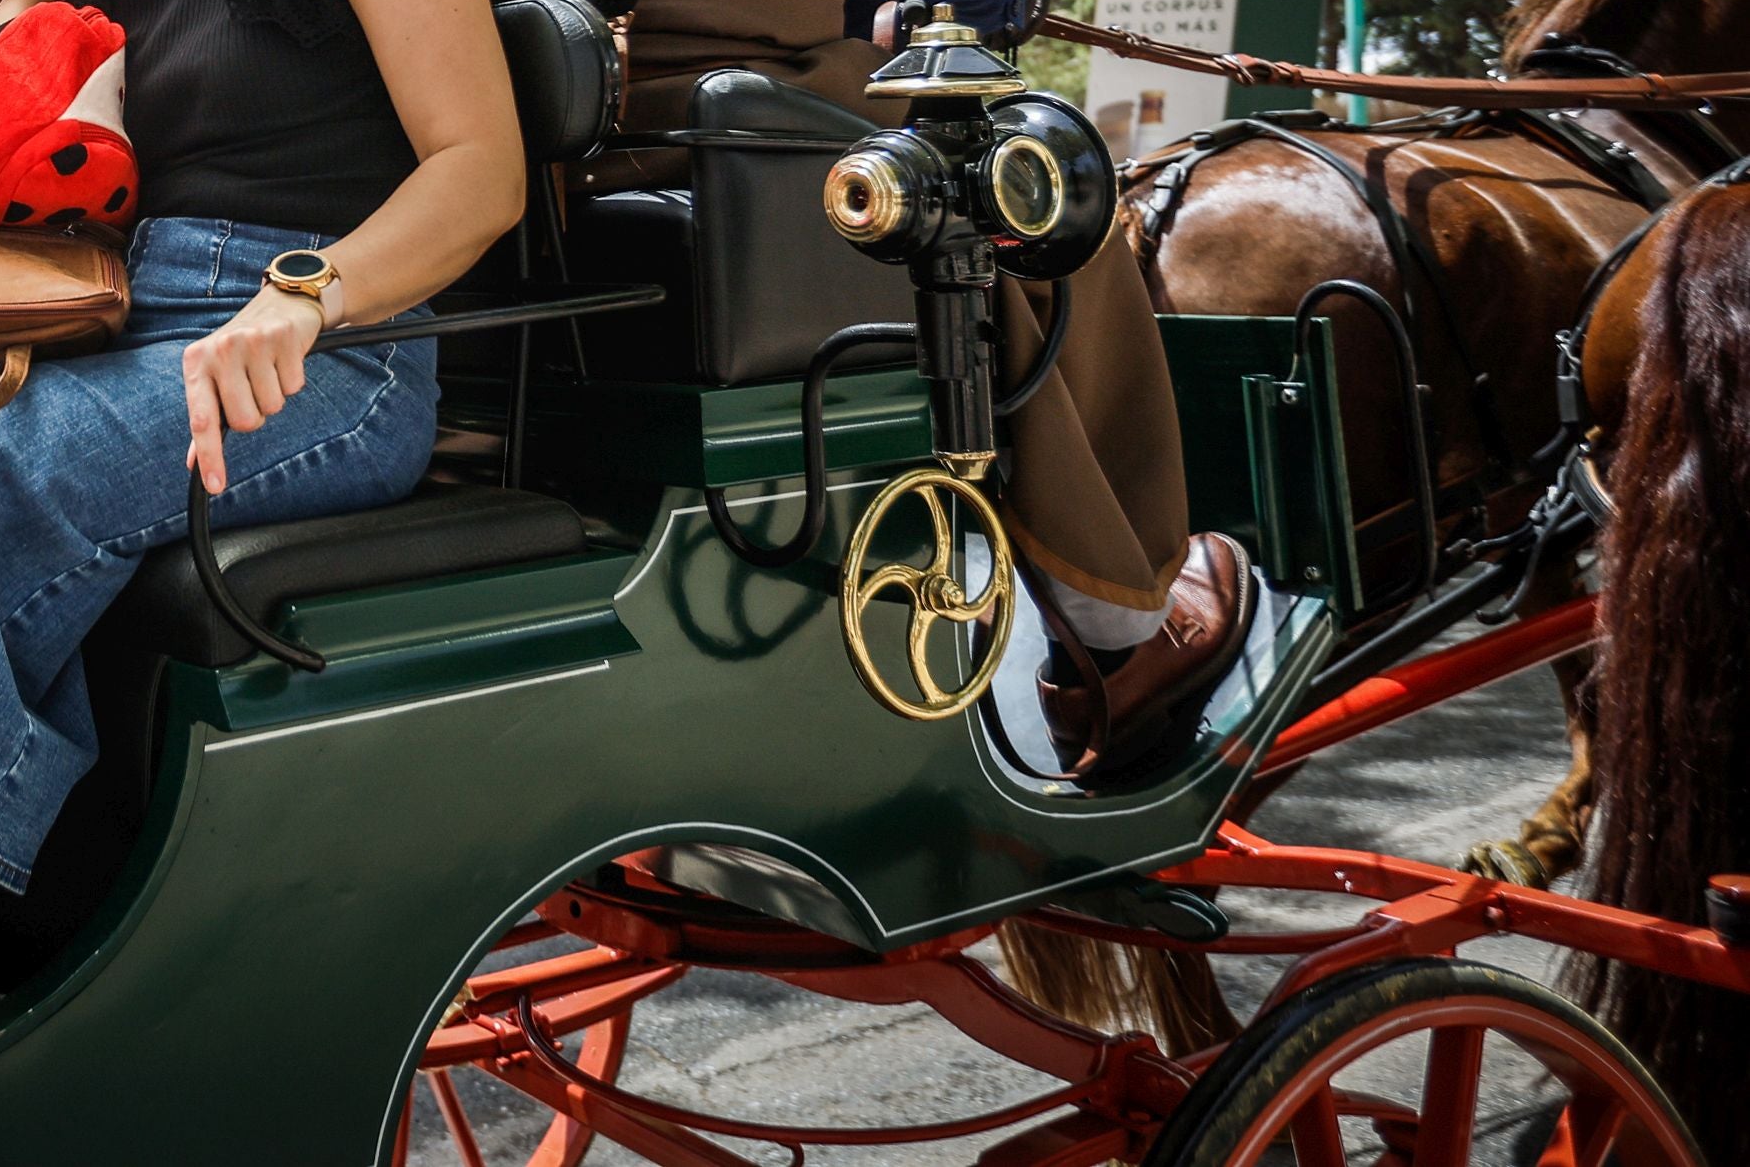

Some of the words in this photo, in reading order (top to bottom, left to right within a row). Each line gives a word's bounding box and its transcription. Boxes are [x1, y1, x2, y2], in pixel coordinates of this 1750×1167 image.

[1107, 2, 1130, 13] UN
[1141, 21, 1165, 33] LO
[1176, 19, 1218, 32] MÁS
